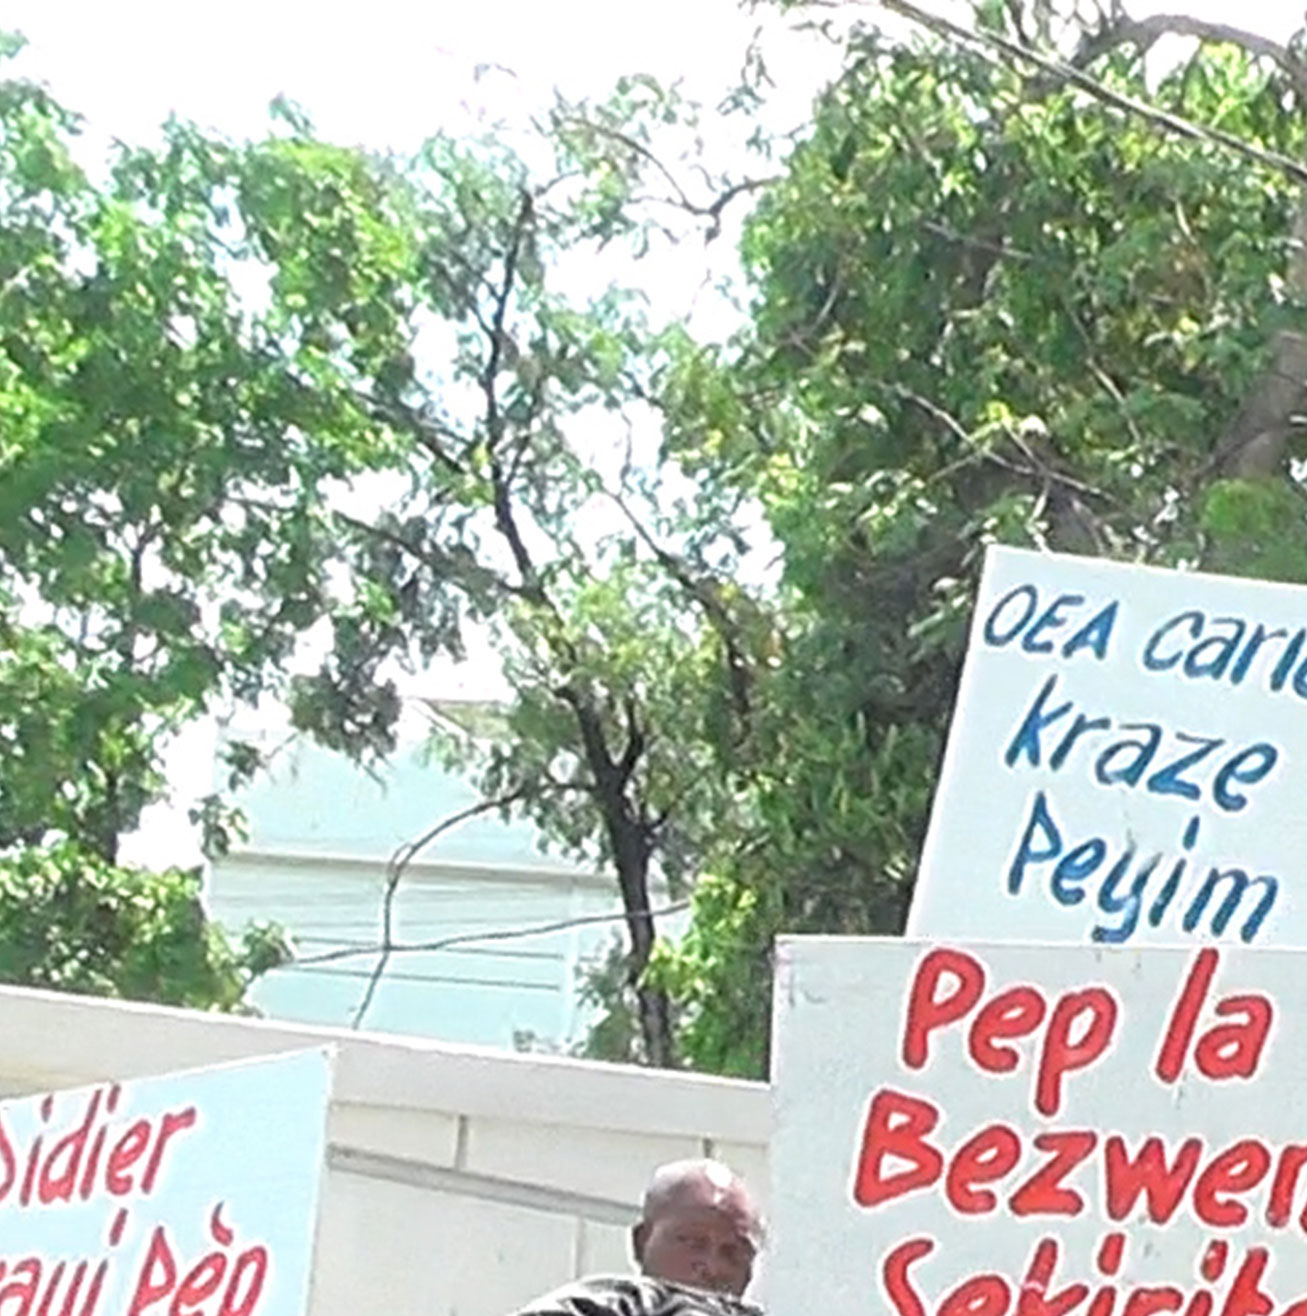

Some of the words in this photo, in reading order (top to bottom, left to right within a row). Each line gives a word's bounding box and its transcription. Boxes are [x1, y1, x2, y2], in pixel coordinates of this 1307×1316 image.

[983, 584, 1120, 661] OEA
[1007, 790, 1280, 943] Peyim
[902, 947, 1118, 1117] Pep
[1155, 947, 1273, 1084] la
